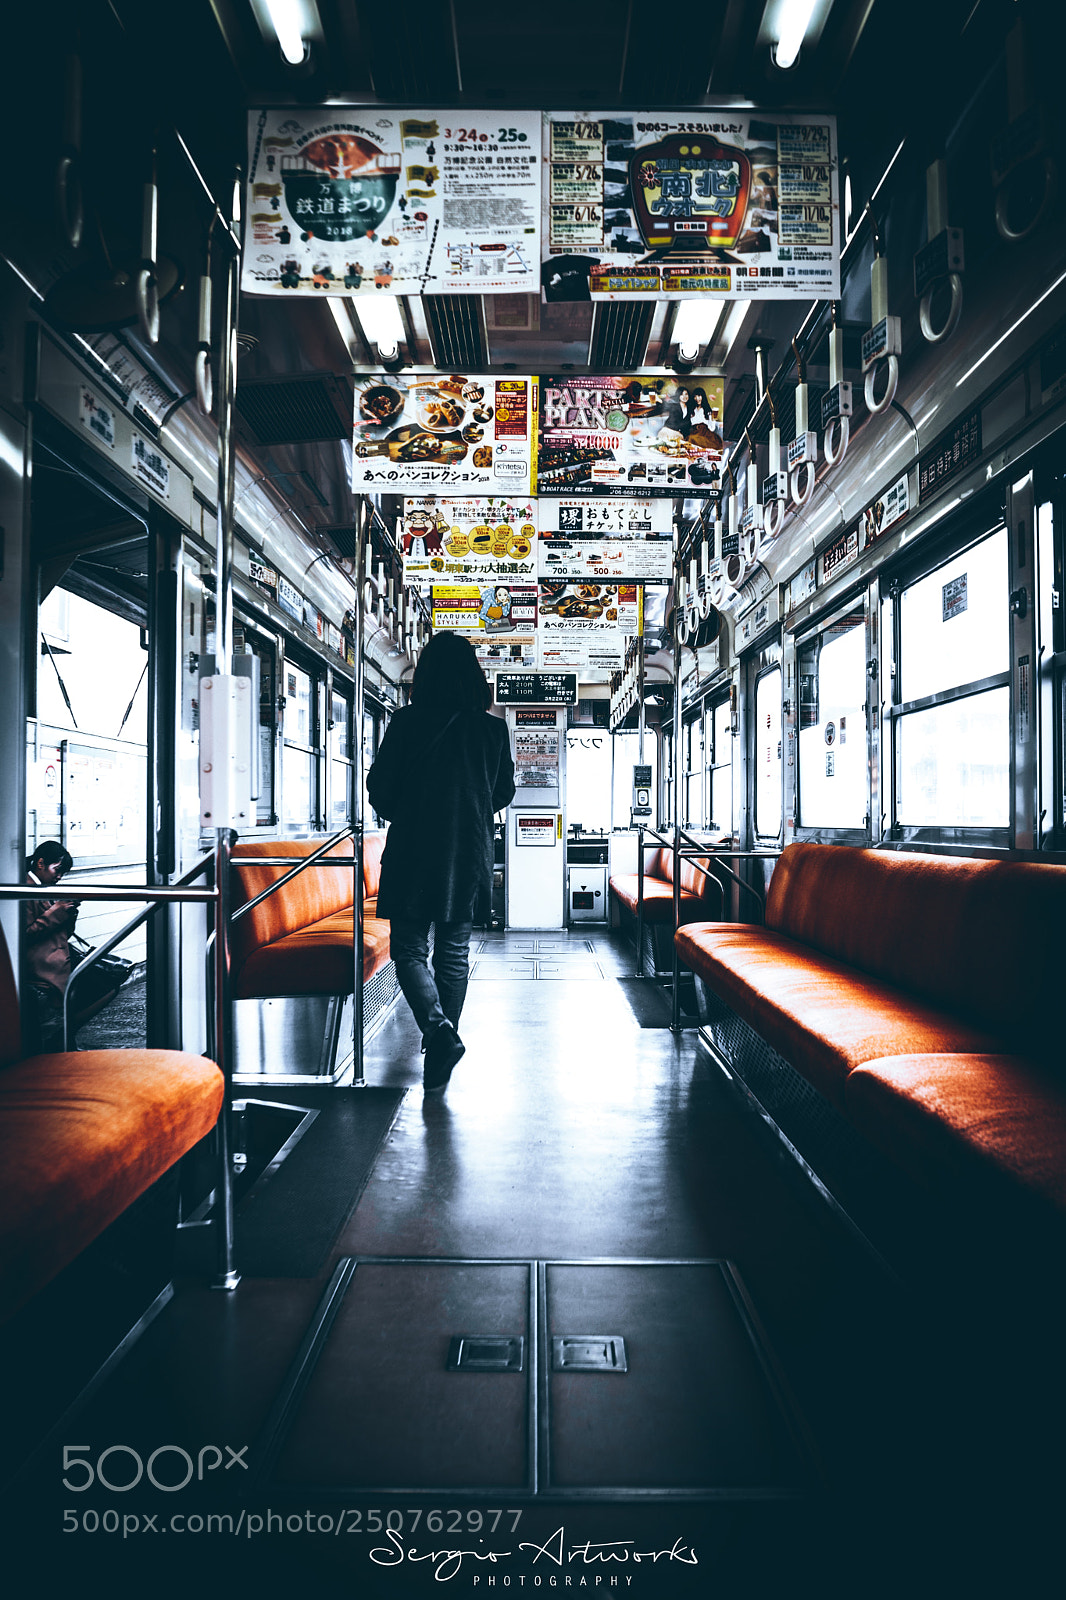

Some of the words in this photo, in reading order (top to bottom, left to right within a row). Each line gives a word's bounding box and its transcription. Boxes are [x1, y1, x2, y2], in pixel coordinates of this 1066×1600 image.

[444, 156, 492, 164] 万博記念公園
[496, 156, 537, 164] 自然文化園
[654, 171, 737, 197] 南北
[296, 196, 386, 214] 鉄道まつり
[327, 226, 353, 236] 2018
[736, 267, 783, 277] 朝日新聞
[609, 278, 658, 288] ドライTシャツ
[680, 278, 728, 289] 地元の特産品
[544, 388, 626, 408] PARTY
[602, 398, 625, 406] SPECIAL
[544, 406, 607, 429] PLAN
[363, 470, 480, 482] あべのパンコレクション
[561, 509, 583, 526] 堺
[587, 507, 652, 520] おもてなし
[586, 521, 625, 530] チケット
